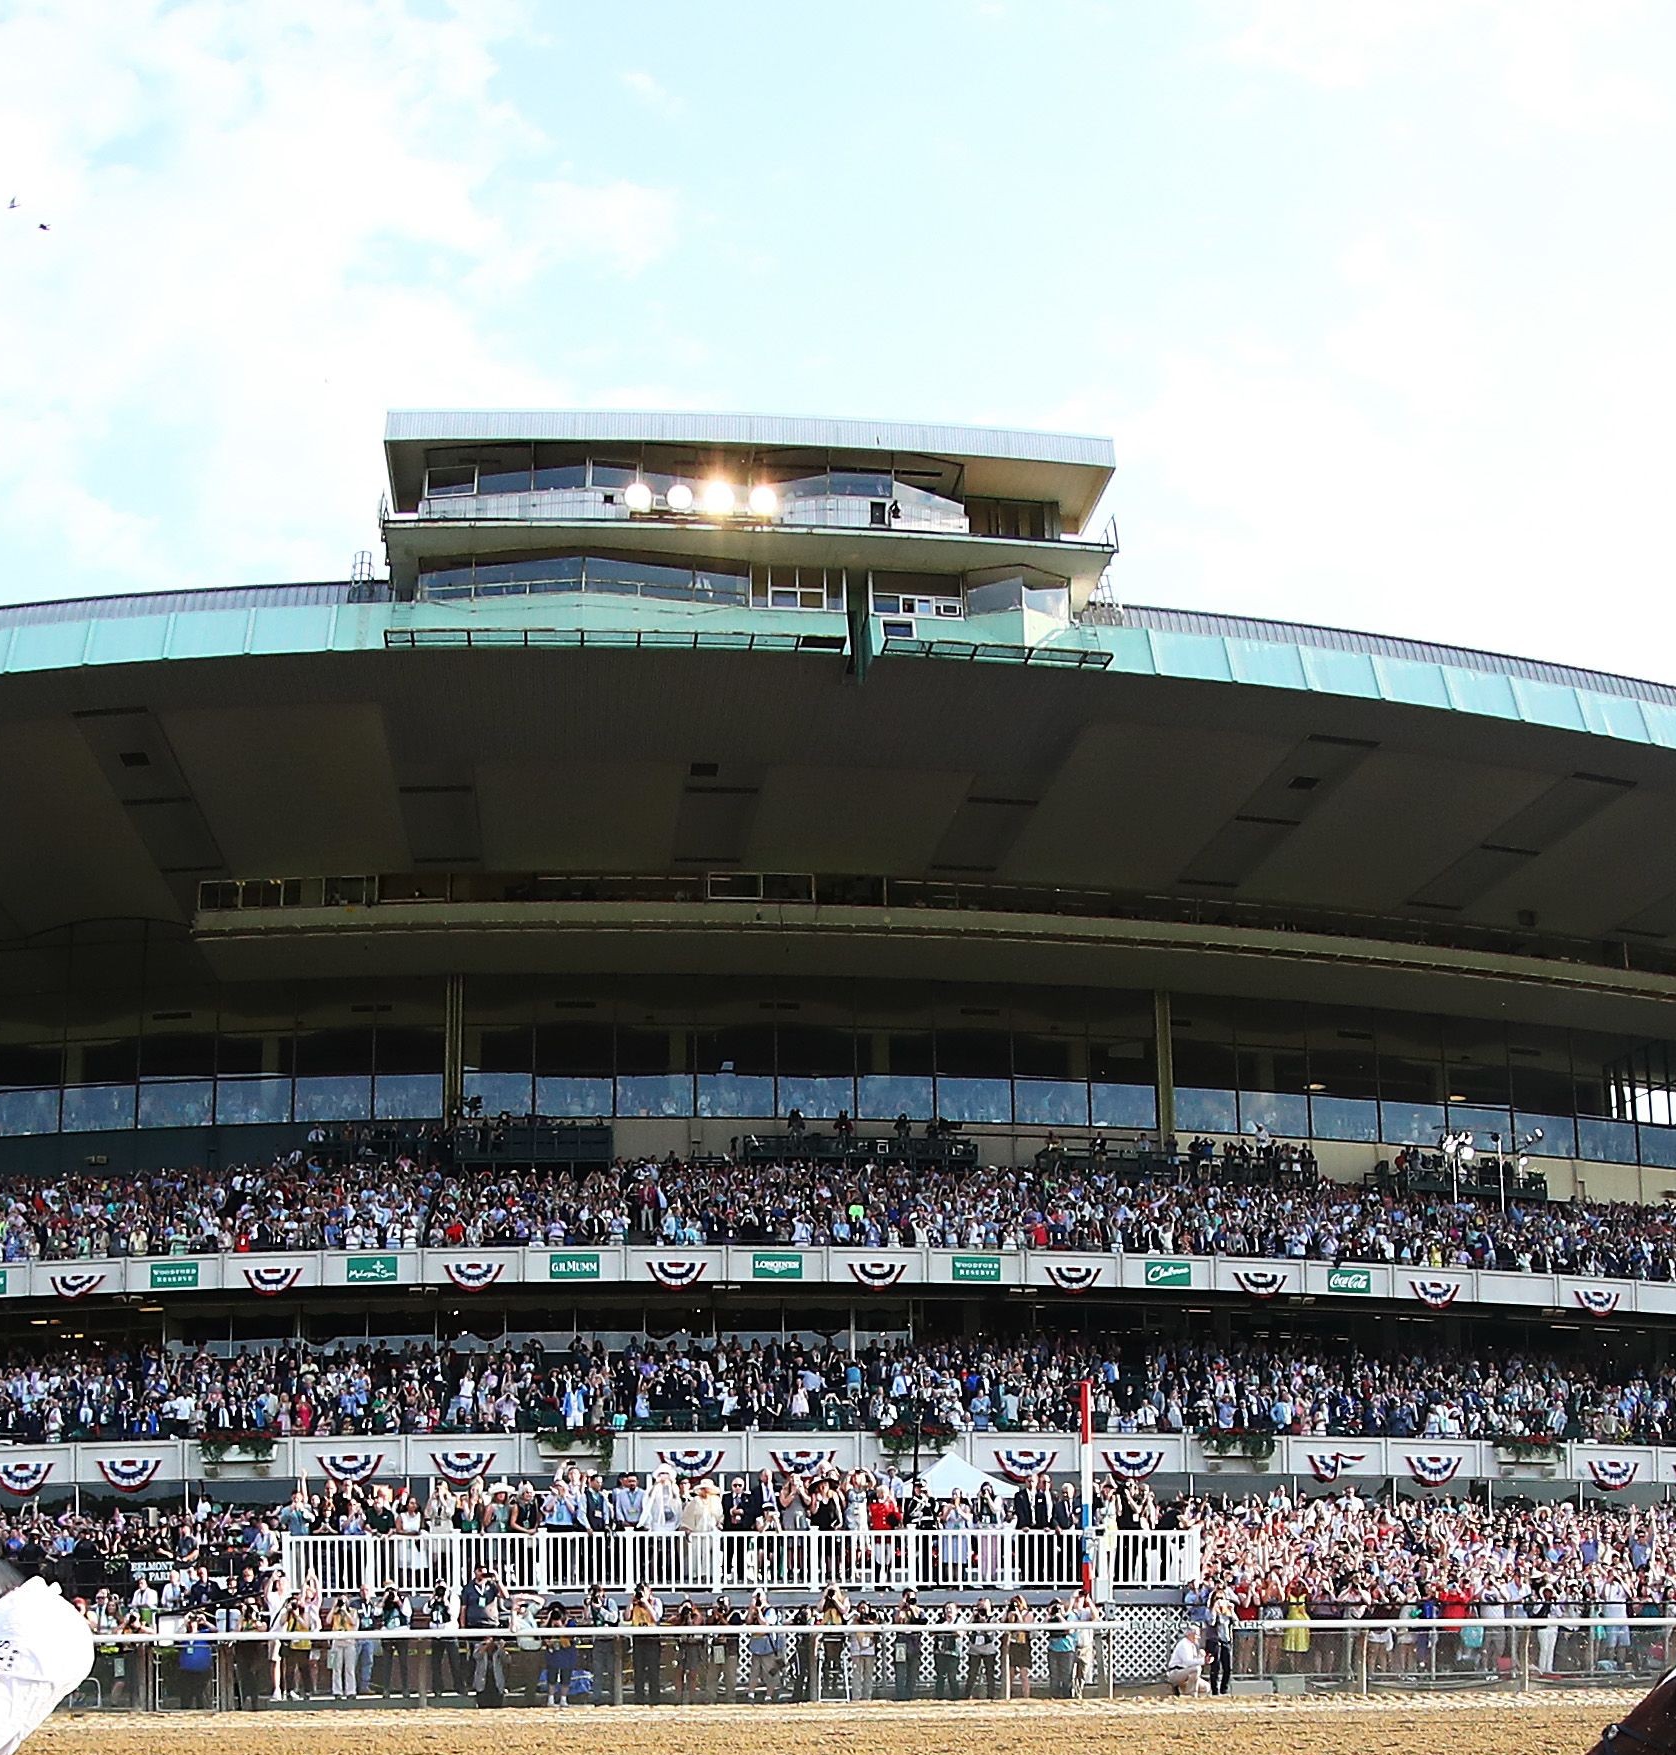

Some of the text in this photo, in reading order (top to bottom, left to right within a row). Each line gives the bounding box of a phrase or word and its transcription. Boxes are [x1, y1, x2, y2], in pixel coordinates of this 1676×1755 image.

[755, 1260, 800, 1269] LONGINES
[130, 1561, 175, 1572] BELMONT
[148, 1571, 171, 1582] PAR
